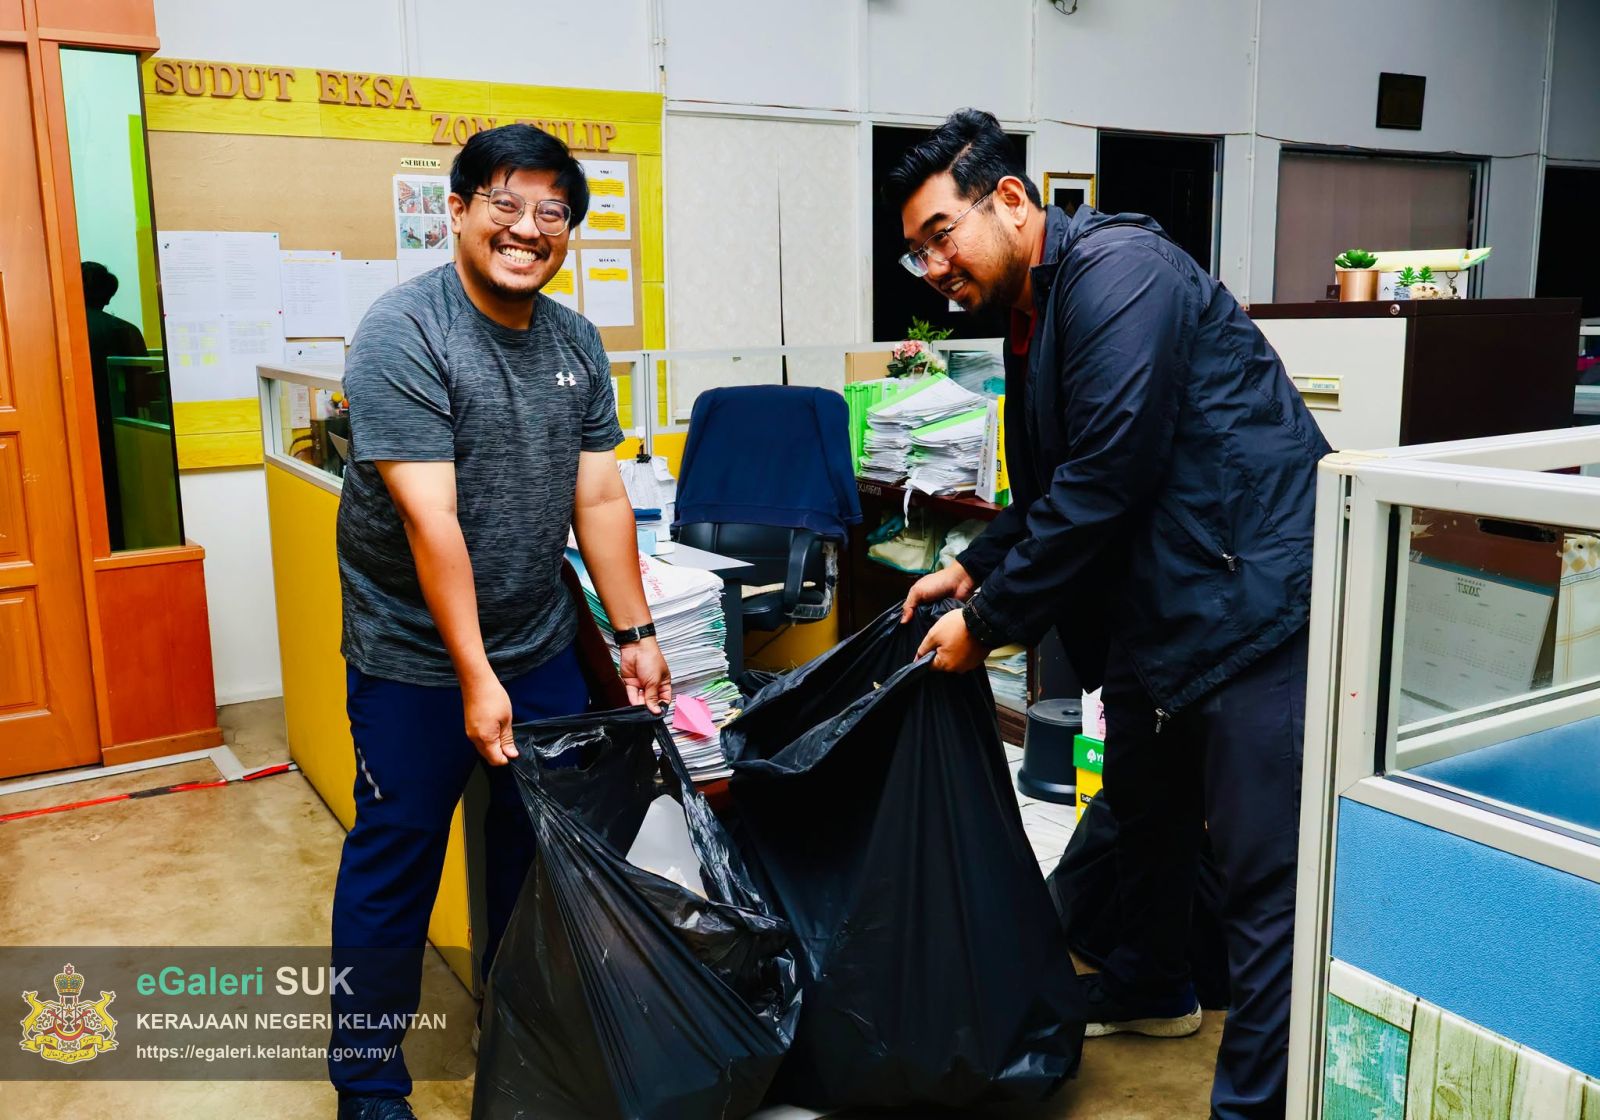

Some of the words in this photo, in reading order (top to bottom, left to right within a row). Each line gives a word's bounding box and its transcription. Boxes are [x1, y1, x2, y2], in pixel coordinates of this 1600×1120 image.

[154, 60, 295, 102] SUDUT
[316, 70, 421, 110] EKSA
[515, 118, 617, 153] ULIP
[404, 159, 437, 168] SEBELUM
